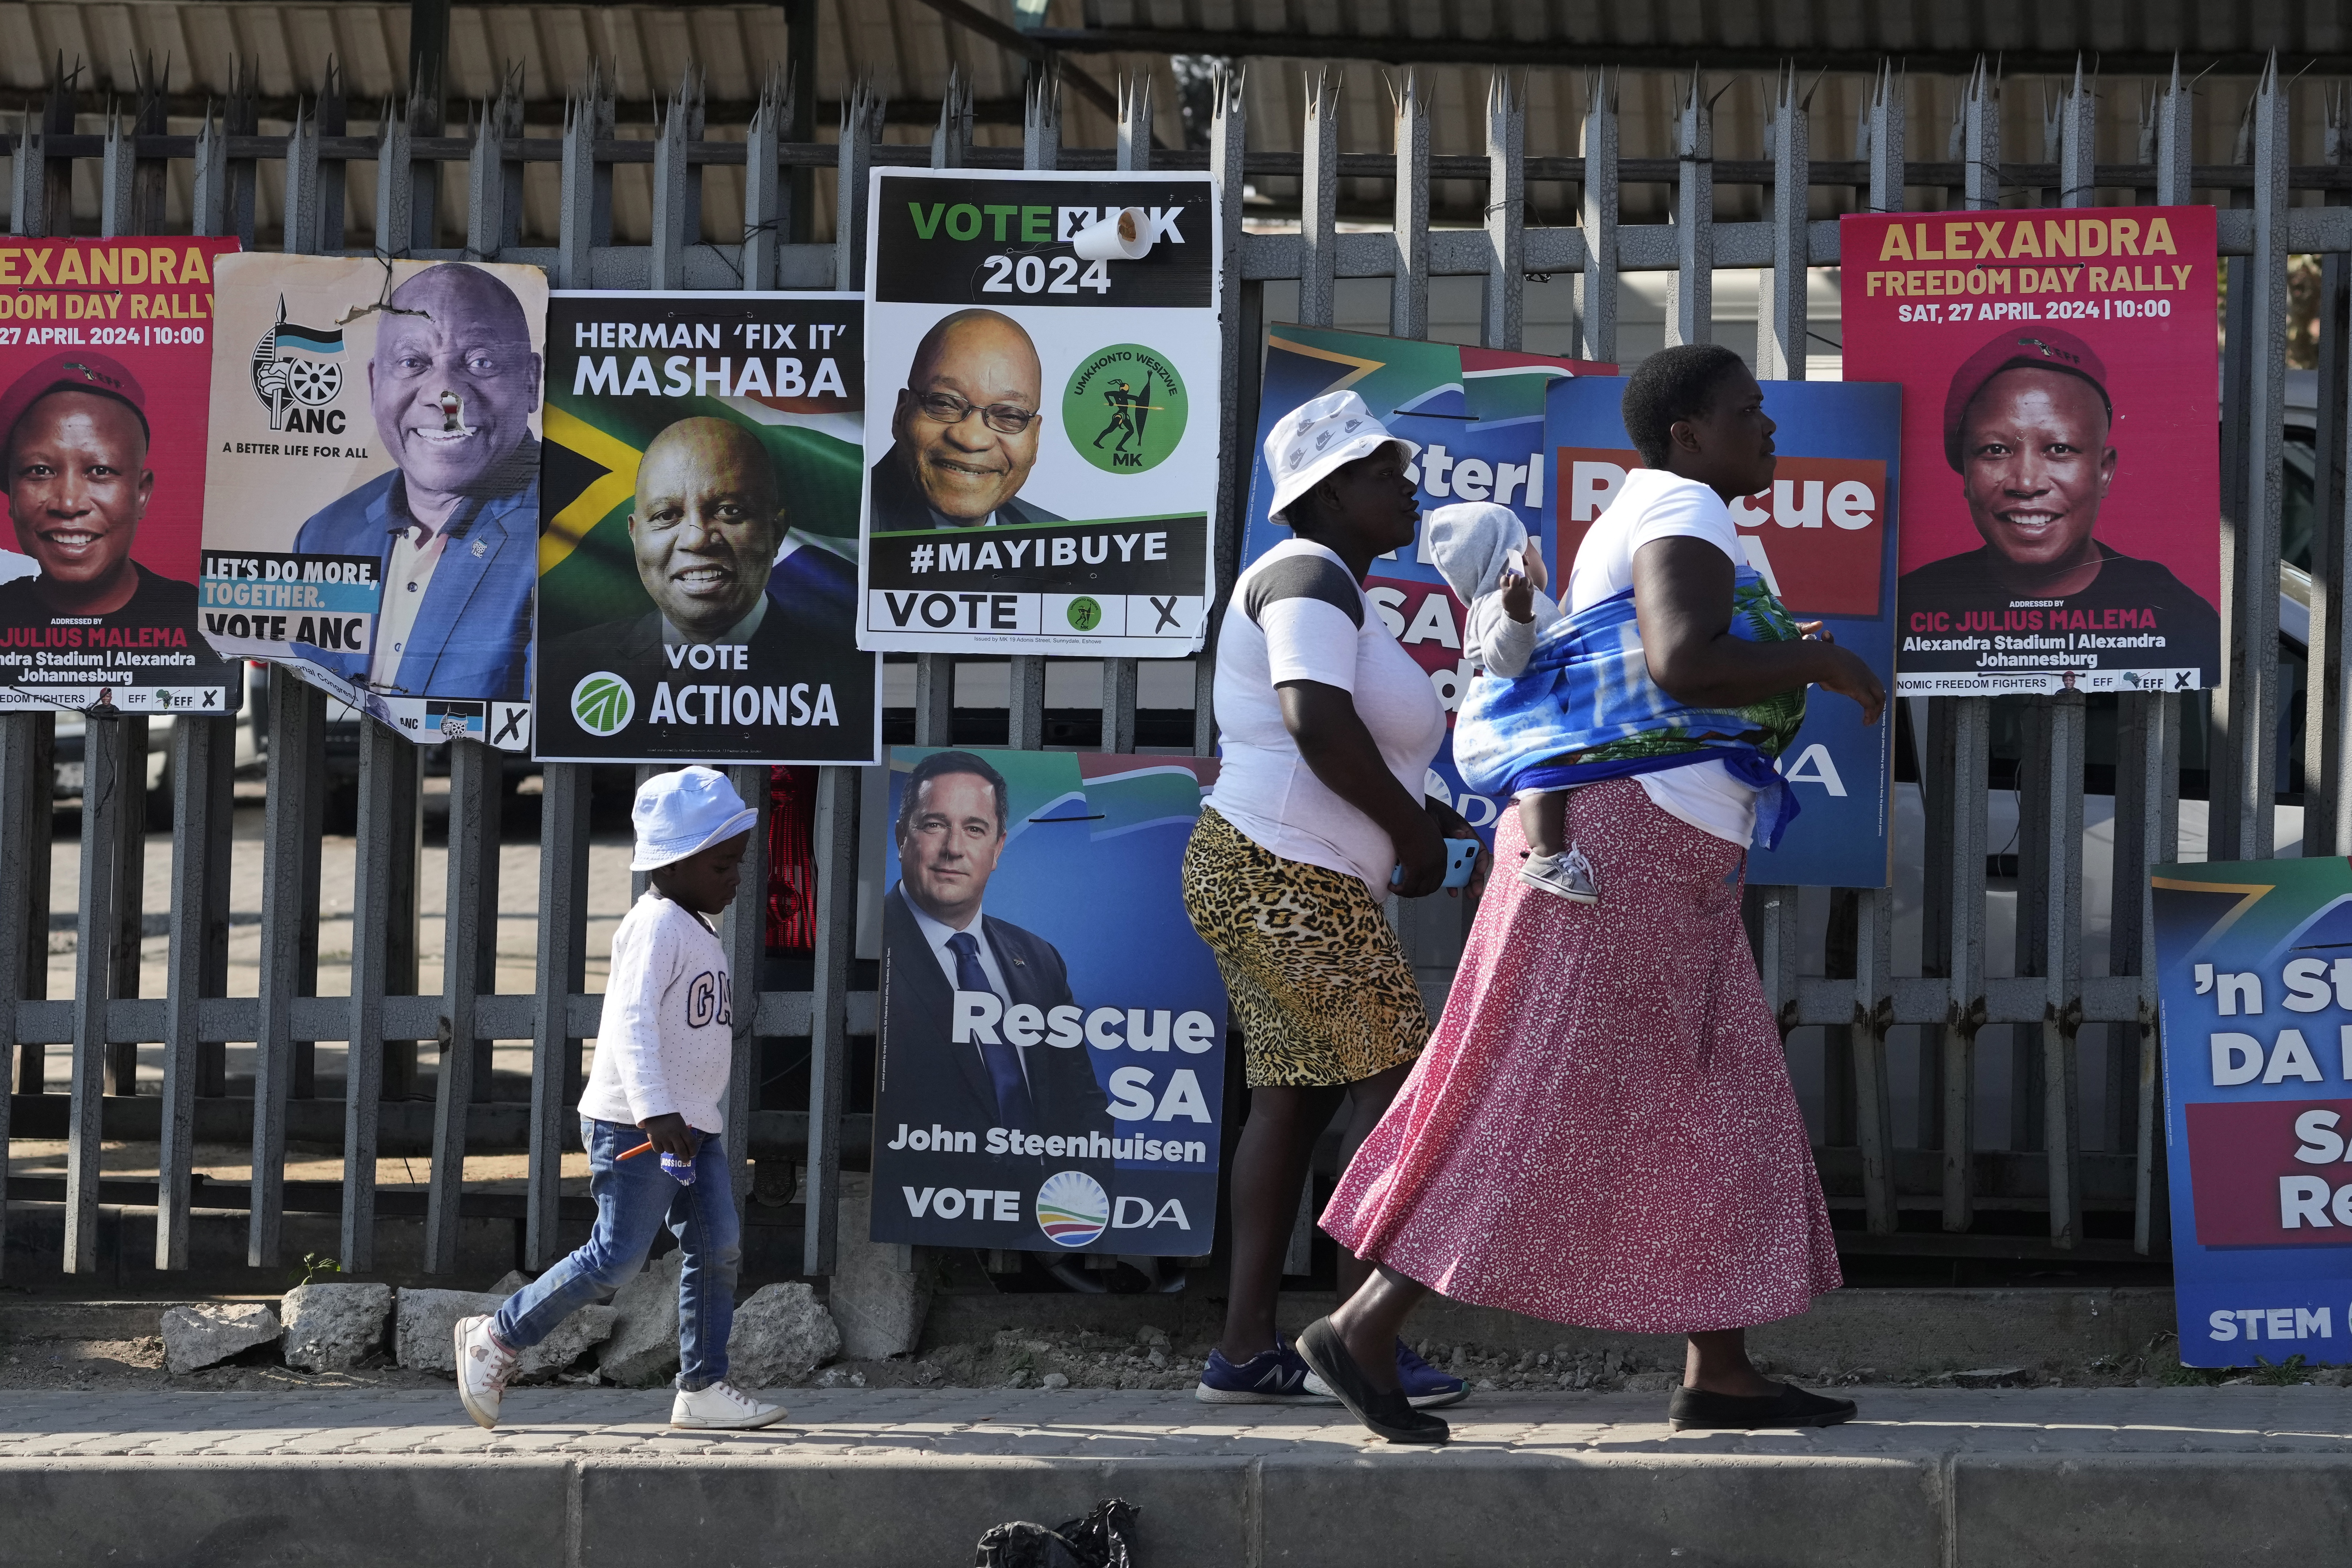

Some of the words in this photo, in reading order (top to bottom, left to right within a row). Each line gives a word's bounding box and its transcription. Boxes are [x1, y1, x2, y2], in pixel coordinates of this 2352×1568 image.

[908, 202, 1052, 242] VOTE
[1105, 206, 1185, 243] K
[1879, 217, 2177, 261] ALEXANDRA
[0, 248, 210, 284] EXANDRA
[982, 255, 1111, 294] 2024
[1866, 268, 2011, 297] FREEDOM
[2019, 267, 2082, 294] DAY
[2089, 265, 2192, 292] RALLY
[0, 294, 57, 319] DOM
[65, 294, 123, 319] DAY
[1899, 304, 1943, 324] SAT,
[1949, 303, 1973, 321] 27
[1978, 301, 2041, 321] APRIL
[2046, 300, 2099, 319] 2024
[2114, 299, 2171, 318] 10:00
[0, 327, 21, 345] 27
[25, 327, 85, 344] APRIL
[90, 327, 140, 344] 2024
[155, 327, 204, 344] 10:00
[576, 323, 720, 349] HERMAN
[572, 355, 848, 397] MASHABA
[1074, 352, 1131, 395] UMKHONTO
[1137, 353, 1178, 396] WESIZWE
[285, 409, 346, 434] ANC
[223, 442, 231, 452] A
[237, 443, 279, 455] BETTER
[285, 445, 308, 456] LIFE
[314, 447, 340, 457] FOR
[345, 448, 368, 458] ALL
[1316, 430, 1330, 446] NIKE
[1113, 454, 1143, 466] MK
[1571, 461, 1875, 530] Rcue
[910, 532, 1167, 574] #MAYIBUYE
[206, 558, 258, 581] LET'S
[265, 560, 298, 583] DO
[303, 562, 378, 590] MORE,
[205, 582, 325, 608] TOGETHER.
[1070, 598, 1086, 610] UMKHONTO
[1087, 599, 1099, 611] WESIZWE
[884, 592, 1017, 629] VOTE
[1910, 612, 1949, 632] CIC
[1956, 610, 2043, 631] JULIUS
[2049, 608, 2156, 630] MALEMA
[0, 628, 82, 647] JULIUS
[88, 628, 187, 647] MALEMA
[205, 613, 286, 641] VOTE
[296, 617, 362, 650] ANC
[1903, 636, 1991, 652] Alexandra
[1994, 634, 2066, 650] Stadium
[2077, 633, 2166, 649] Alexandra
[36, 652, 103, 666] Stadium
[115, 652, 195, 666] Alexandra
[664, 644, 748, 670] VOTE
[1976, 652, 2098, 669] Johannesburg
[18, 668, 133, 685] Johannesburg
[317, 673, 358, 701] Congress
[1897, 680, 1933, 690] NOMIC
[1935, 679, 1989, 689] FREEDOM
[1992, 679, 2047, 688] FIGHTERS
[2094, 678, 2113, 686] EFF
[2144, 679, 2163, 688] EFF
[174, 697, 193, 706] EFF
[649, 682, 839, 726] ACTIONSA
[400, 717, 418, 729] ANC
[2195, 964, 2263, 1016] 'n
[952, 990, 1215, 1054] Rescue
[2210, 1029, 2323, 1086] DA
[1105, 1066, 1212, 1123] SA
[888, 1123, 976, 1153] John
[985, 1127, 1206, 1162] Steenhuisen
[902, 1186, 1020, 1222] VOTE
[1111, 1196, 1191, 1230] DA
[2209, 1307, 2332, 1342] STEM
